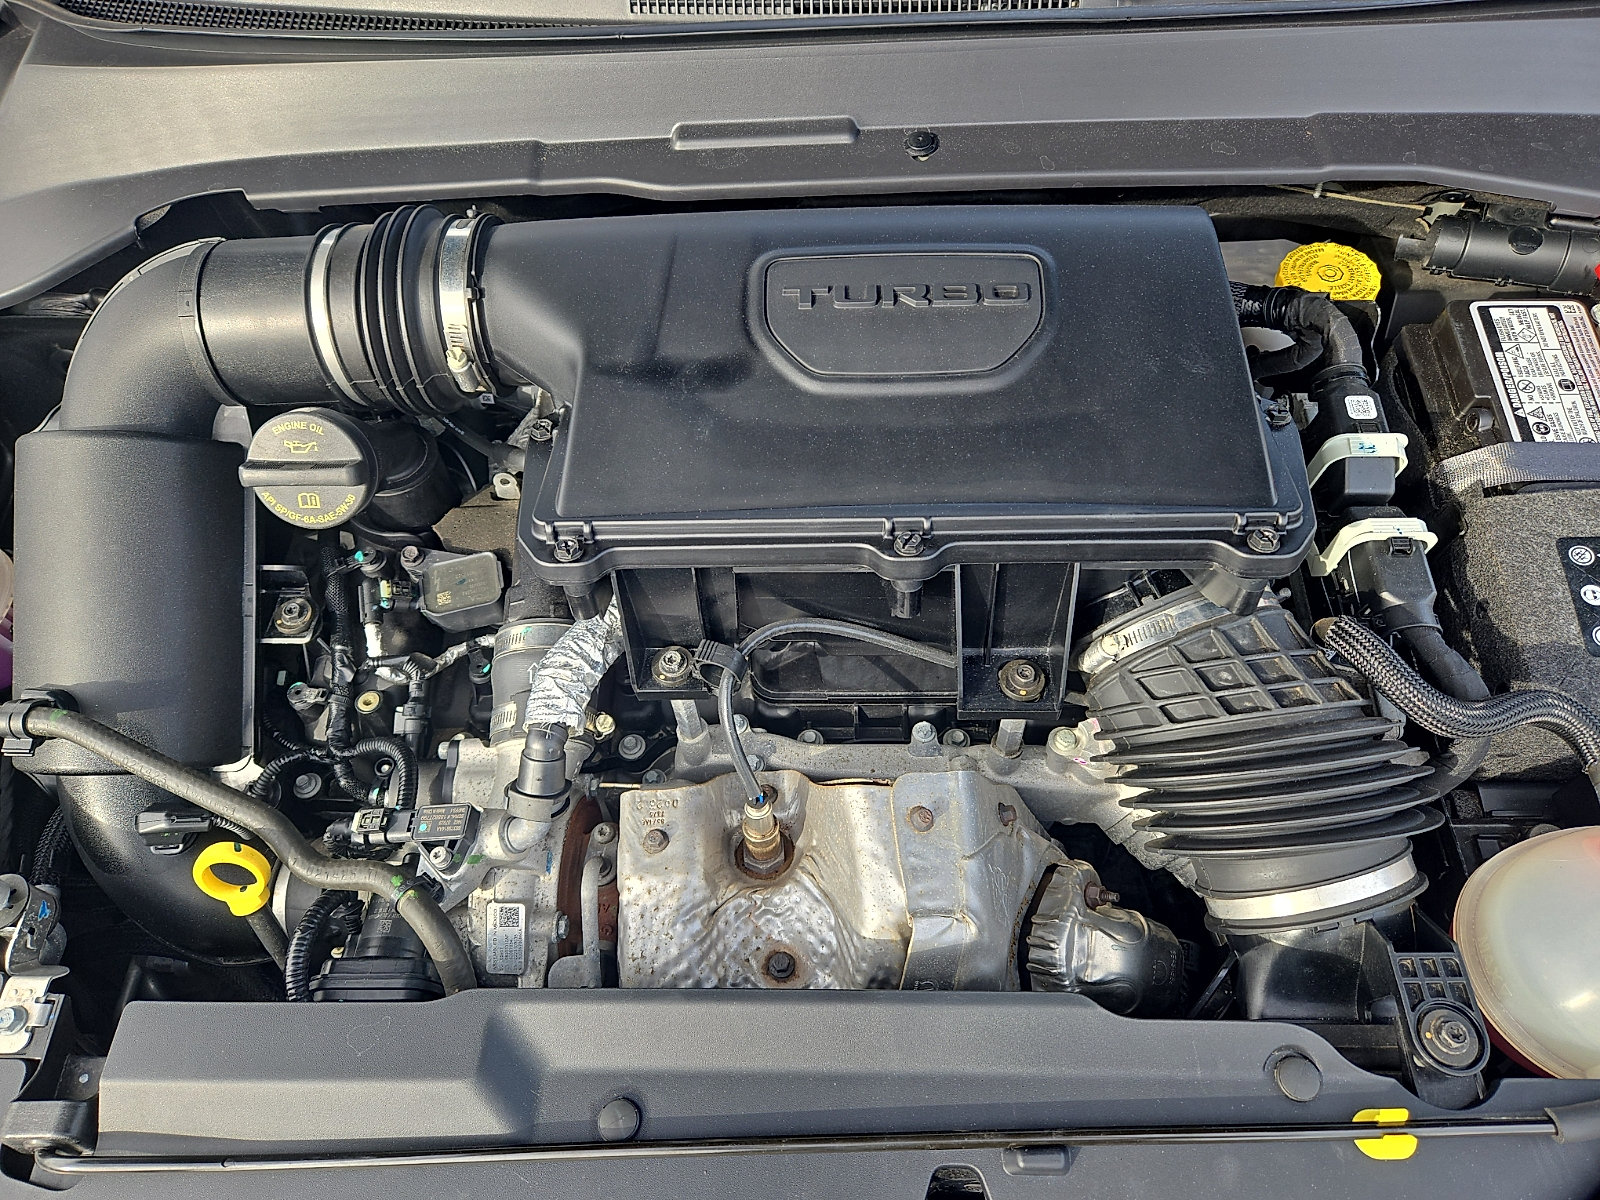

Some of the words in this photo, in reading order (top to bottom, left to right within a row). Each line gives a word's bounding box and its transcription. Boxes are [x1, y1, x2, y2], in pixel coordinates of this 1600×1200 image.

[781, 282, 1031, 308] TURBO
[1495, 352, 1522, 407] DANGER/POISON
[271, 420, 308, 436] ENGINE
[309, 423, 325, 436] OIL
[261, 490, 276, 506] API
[274, 493, 356, 524] SP/GF-6A-SAE-5W-30
